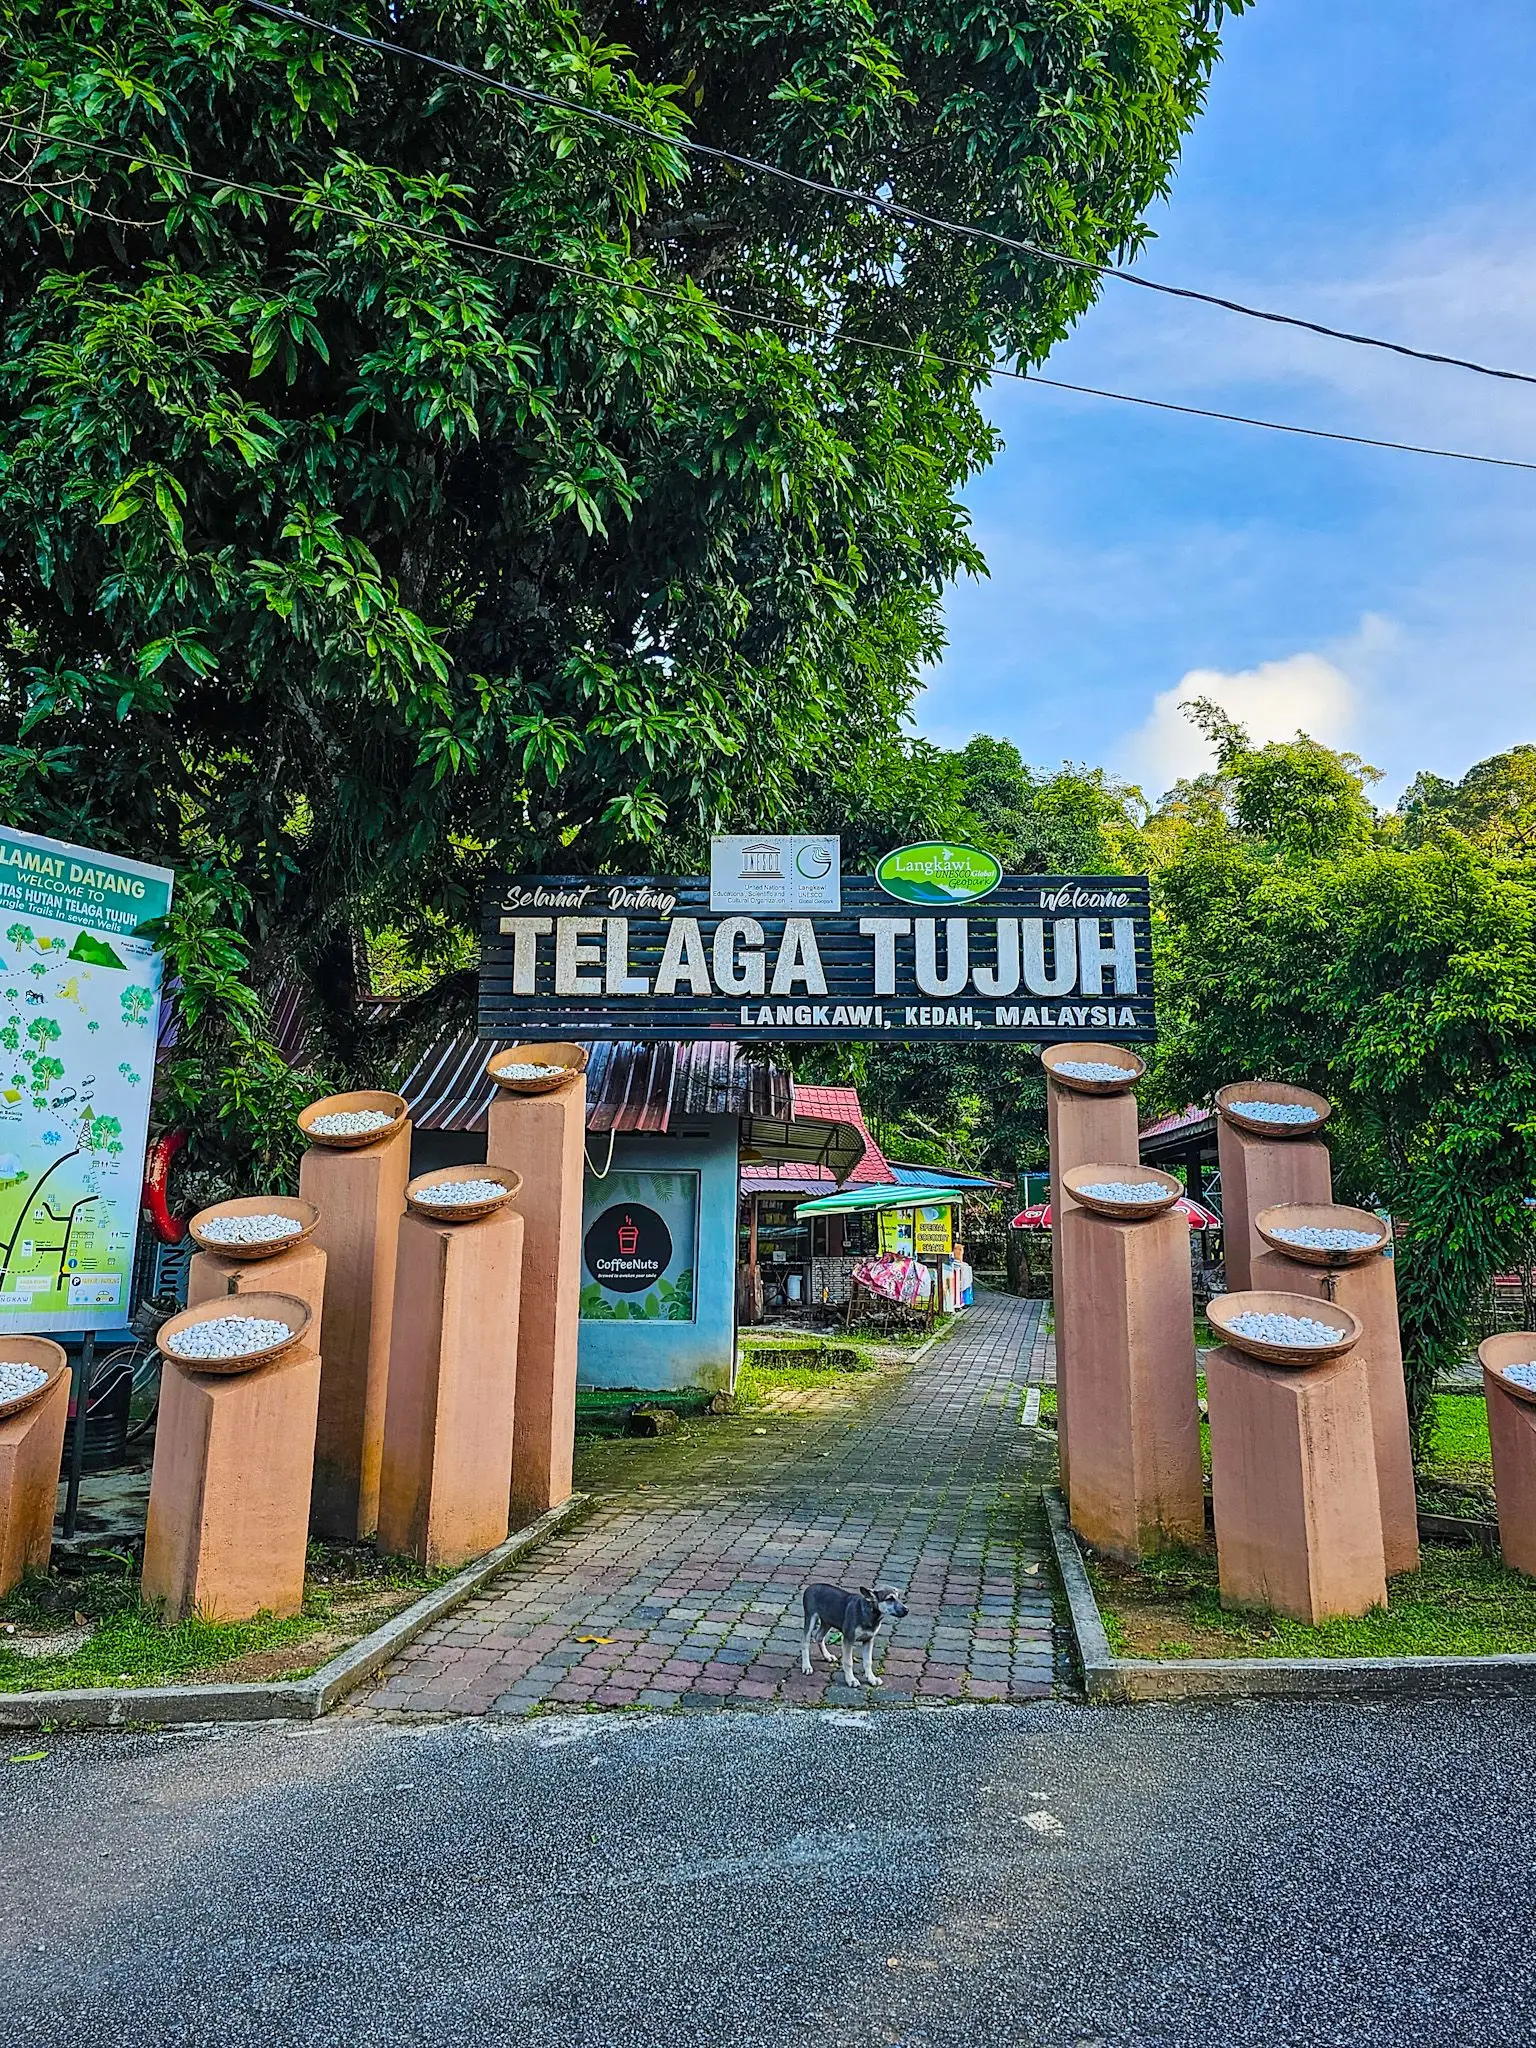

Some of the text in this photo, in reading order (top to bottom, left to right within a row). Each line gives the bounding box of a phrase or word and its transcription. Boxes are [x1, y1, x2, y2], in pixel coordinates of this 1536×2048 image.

[743, 853, 780, 871] UNESCO
[895, 857, 971, 876] Langkawi
[935, 870, 995, 879] UNESCO Global
[17, 871, 105, 903] WELCOME TO
[69, 864, 146, 899] DATANG
[948, 878, 992, 889] Geopark
[24, 888, 63, 909] HUTAN
[65, 898, 103, 919] TELAGA
[105, 907, 138, 927] TUJUH
[500, 885, 677, 916] Selamat Datang
[1039, 882, 1130, 912] Welcome
[28, 902, 54, 917] Trails
[67, 914, 95, 926] seven
[97, 918, 122, 932] Wells
[499, 916, 1138, 997] TELAGA TUJUH
[740, 1005, 1136, 1030] LANGKAWI, KEDAH, MALAYSIA
[596, 1258, 659, 1272] CoffeeNuts
